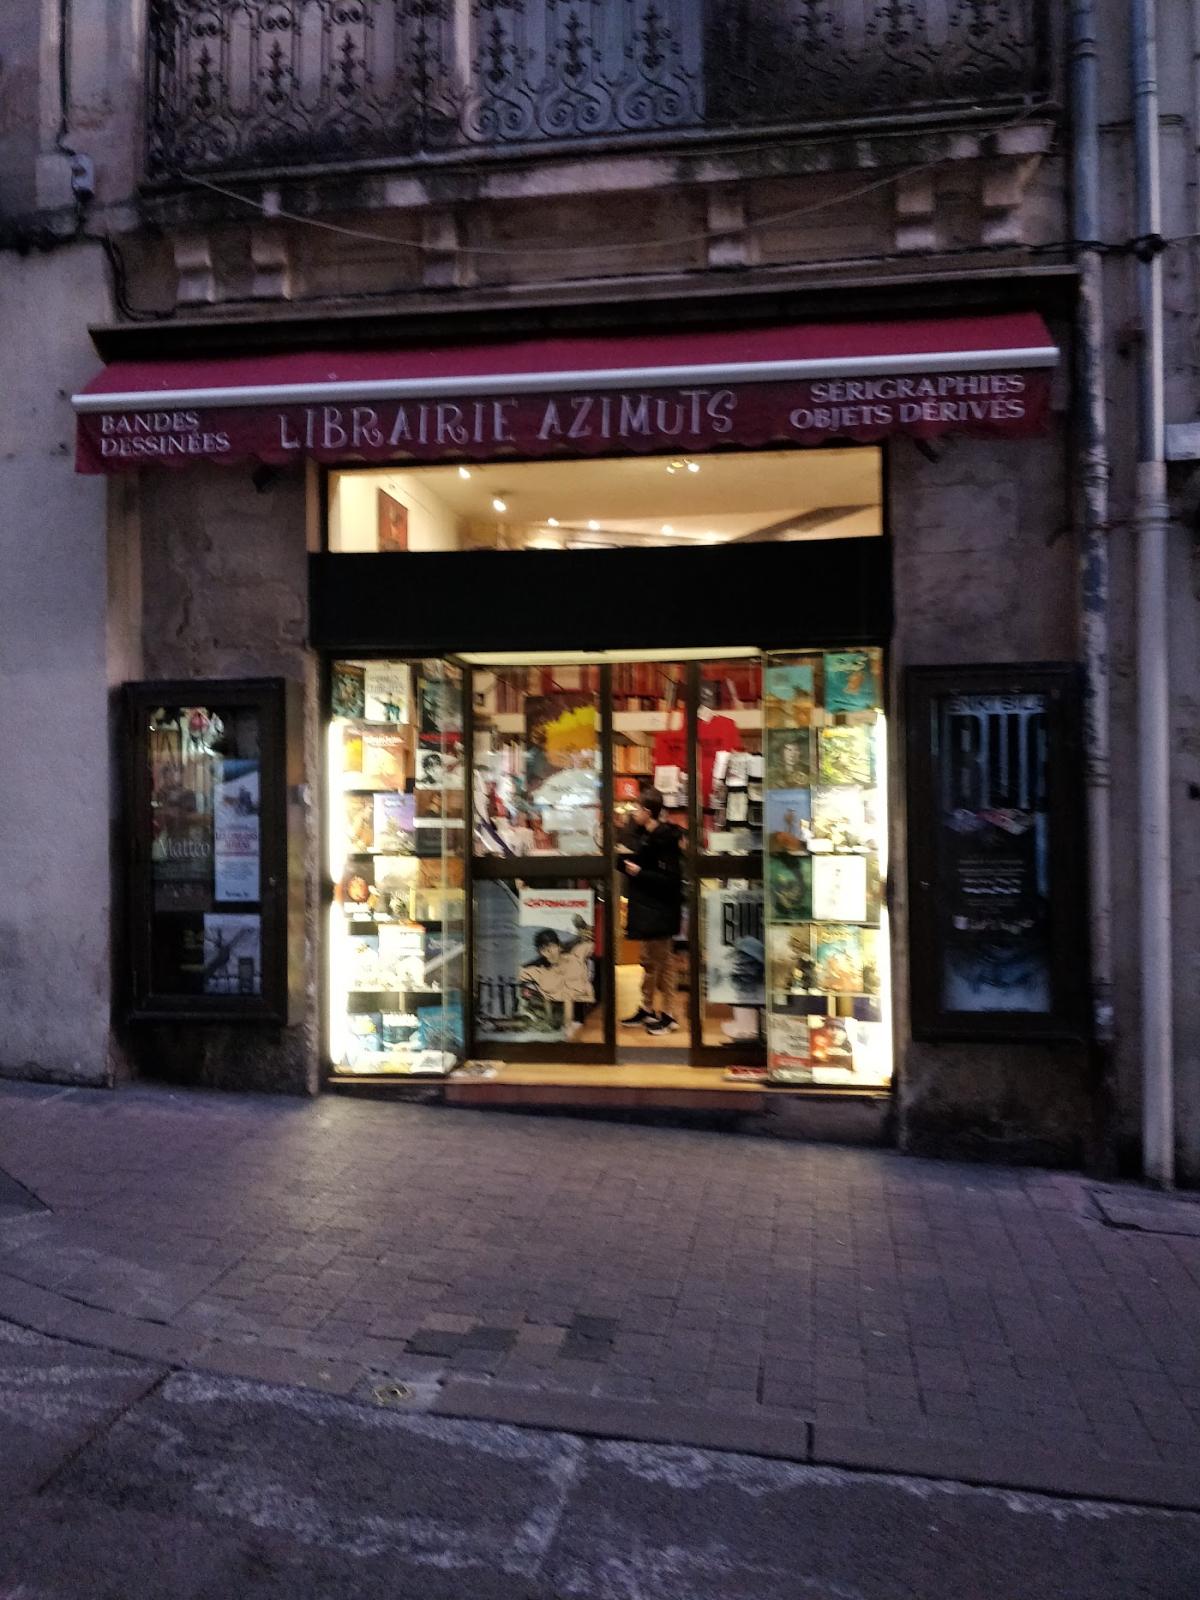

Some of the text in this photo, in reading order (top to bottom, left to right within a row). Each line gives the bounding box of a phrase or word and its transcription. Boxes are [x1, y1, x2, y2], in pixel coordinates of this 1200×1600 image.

[810, 374, 1026, 403] SÉRIGRAPHIES
[101, 411, 200, 435] BANDES
[279, 389, 737, 450] LIBRAIRIE AZIMUTS
[790, 395, 1026, 431] OBJETS DÉRIVÉS
[101, 429, 231, 457] DESSINÉES
